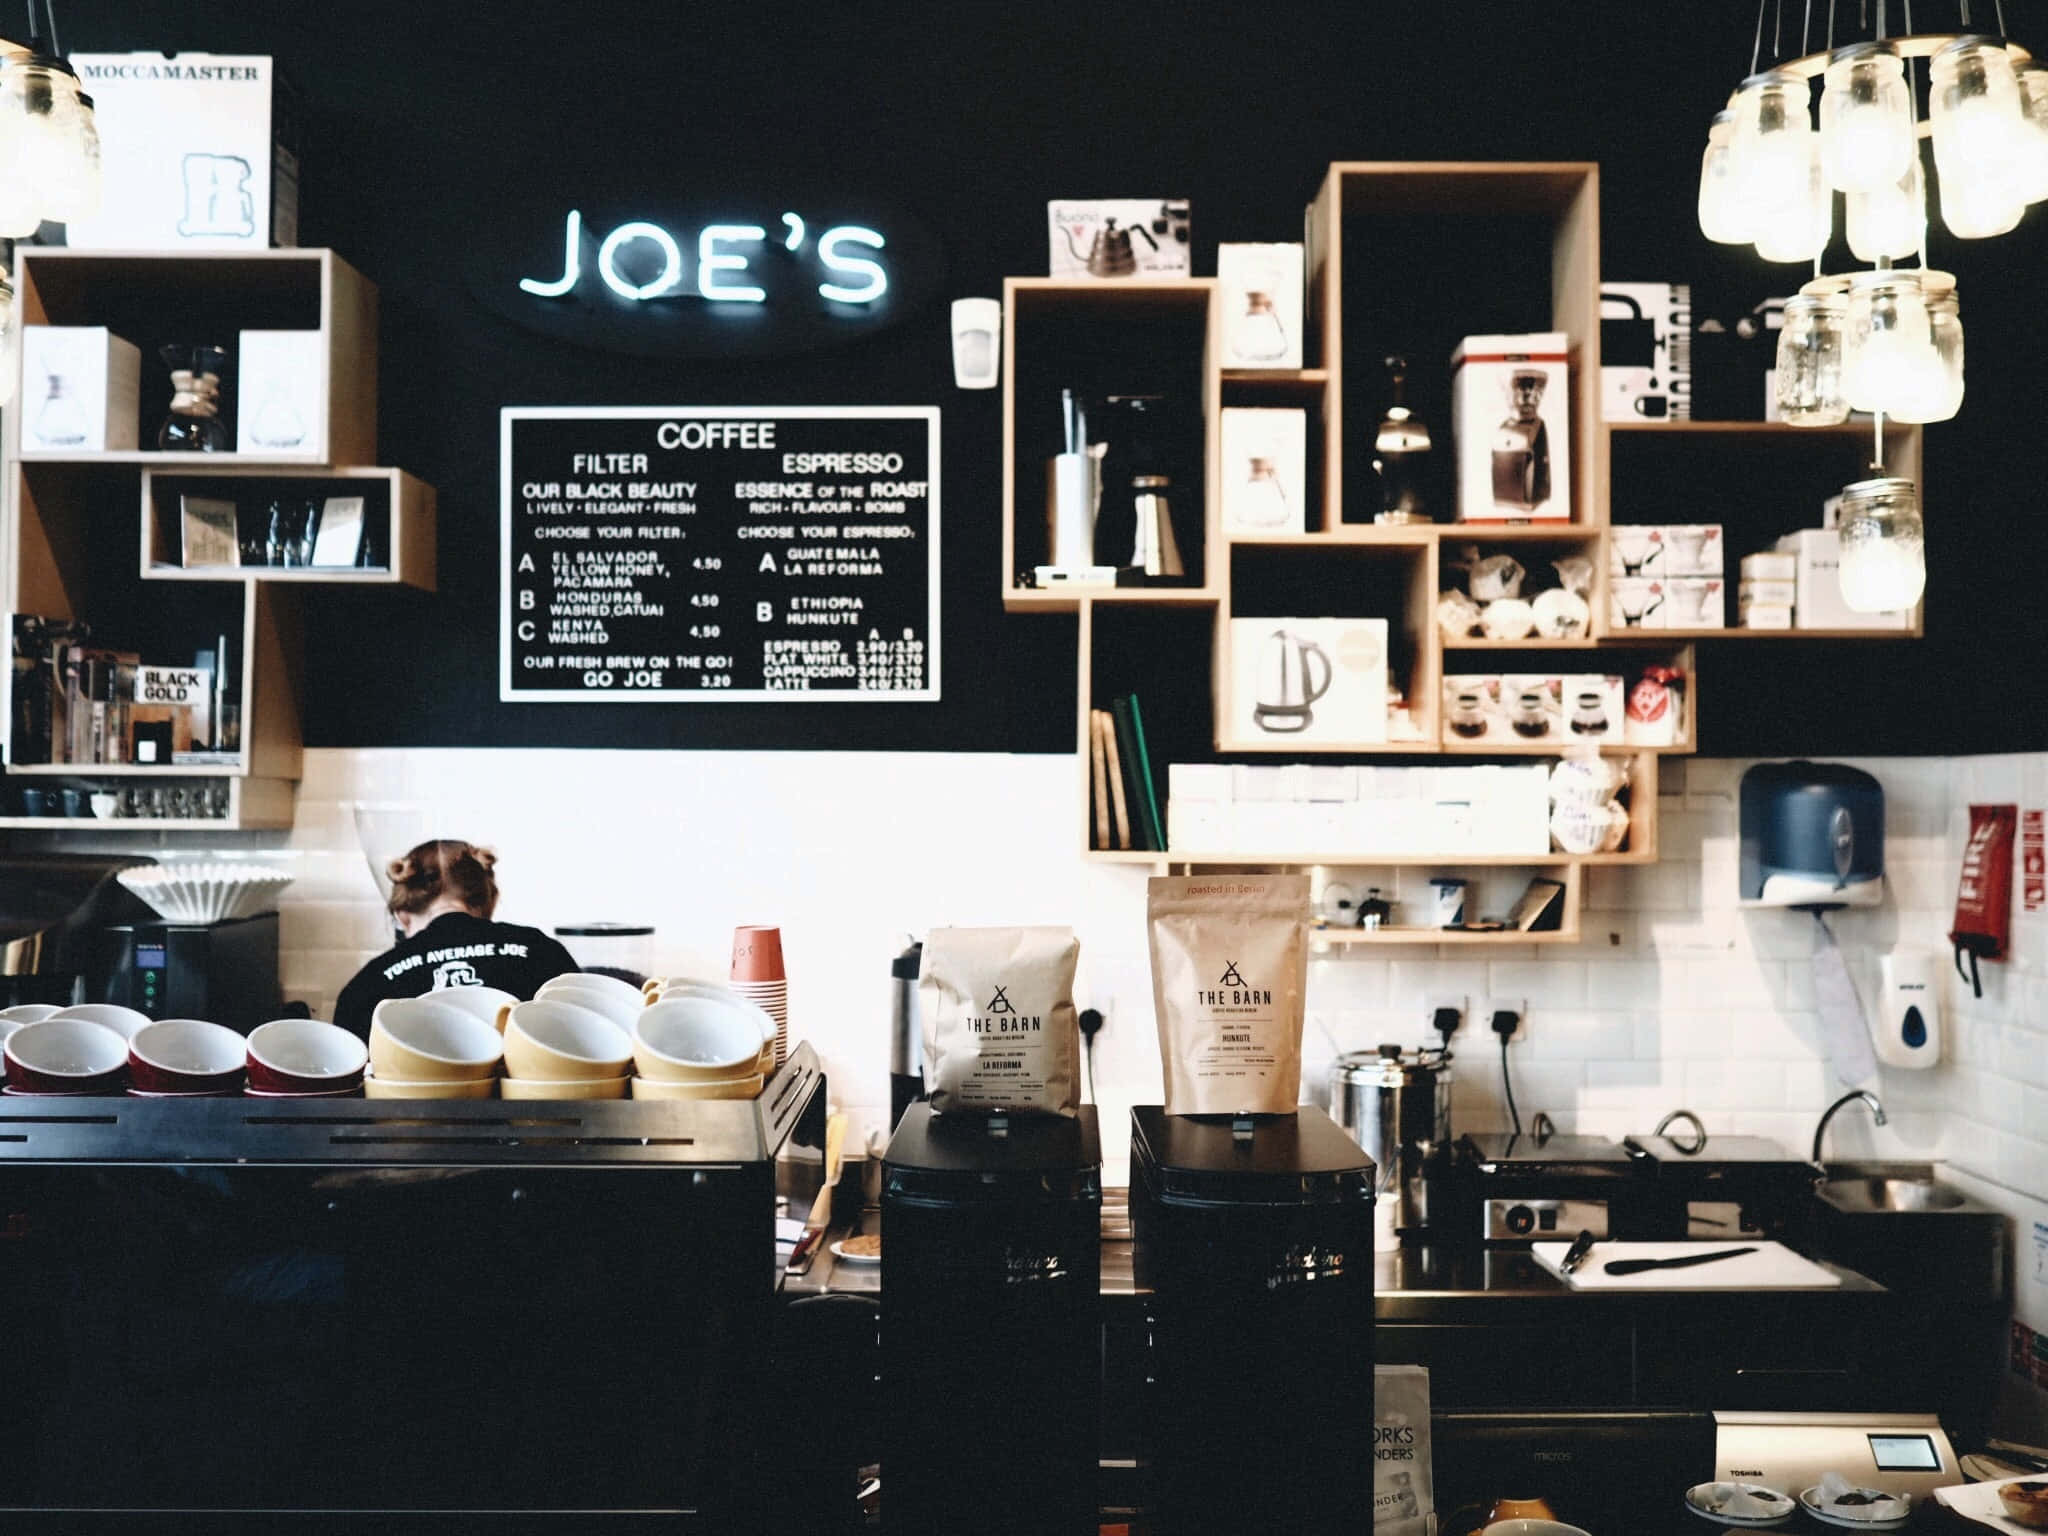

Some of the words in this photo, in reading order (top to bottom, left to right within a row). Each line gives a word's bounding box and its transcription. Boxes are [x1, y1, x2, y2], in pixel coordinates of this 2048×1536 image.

[84, 64, 259, 81] MOCCAMASTER
[519, 209, 888, 303] JOE'S
[657, 422, 776, 449] COFFEE
[573, 454, 648, 474] FILTER
[782, 453, 903, 473] ESPRESSO
[522, 483, 560, 498] OUR
[565, 483, 622, 498] BLACK
[628, 483, 697, 499] BEAUTY
[735, 482, 813, 498] ESSENCE
[817, 486, 836, 498] OF
[840, 486, 864, 498] THE
[870, 482, 928, 498] ROAST
[527, 502, 573, 514] LIVELY
[585, 502, 644, 514] ELEGANT
[653, 502, 697, 514] FRESH
[749, 502, 782, 514] RICH
[791, 502, 852, 514] FLAVOUR
[534, 526, 591, 539] CHOOSE
[597, 526, 633, 539] YOUR
[737, 525, 794, 539] CHOOSE
[801, 525, 838, 539] YOUR
[552, 551, 570, 564] EL
[576, 551, 658, 564] SALVADOR
[787, 547, 880, 560] GUATEMALA
[518, 553, 535, 573] A
[759, 552, 777, 572] A
[784, 563, 803, 575] LA
[807, 563, 883, 575] REFORMA
[551, 564, 610, 577] YELLOW
[554, 576, 633, 588] PACAMARA
[520, 590, 535, 610] B
[556, 591, 643, 604] HONDURAS
[790, 597, 864, 609] ETHIOPIA
[756, 602, 773, 622] B
[786, 613, 859, 625] HUNKUTE
[517, 621, 536, 641] C
[552, 620, 604, 632] KENYA
[548, 632, 609, 644] WASHED
[763, 640, 841, 653] ESPRESSO
[523, 656, 554, 669] OUR
[558, 656, 600, 669] FRESH
[606, 656, 645, 669] BREW
[650, 656, 670, 669] ON
[676, 656, 700, 669] THE
[763, 654, 797, 665] FLAT
[802, 653, 849, 665] WHITE
[144, 672, 200, 686] BLACK
[762, 666, 856, 678] CAPPUCCINO
[583, 671, 614, 688] GO
[623, 671, 663, 688] JOE
[765, 679, 810, 690] LATTE
[144, 687, 187, 701] GOLD
[383, 954, 424, 980] YOUR
[426, 943, 495, 964] AVERAGE
[498, 943, 528, 957] JOE
[1198, 991, 1225, 1006] THE
[1233, 990, 1271, 1005] BARN
[967, 1017, 992, 1033] THE
[1000, 1016, 1040, 1032] BARN
